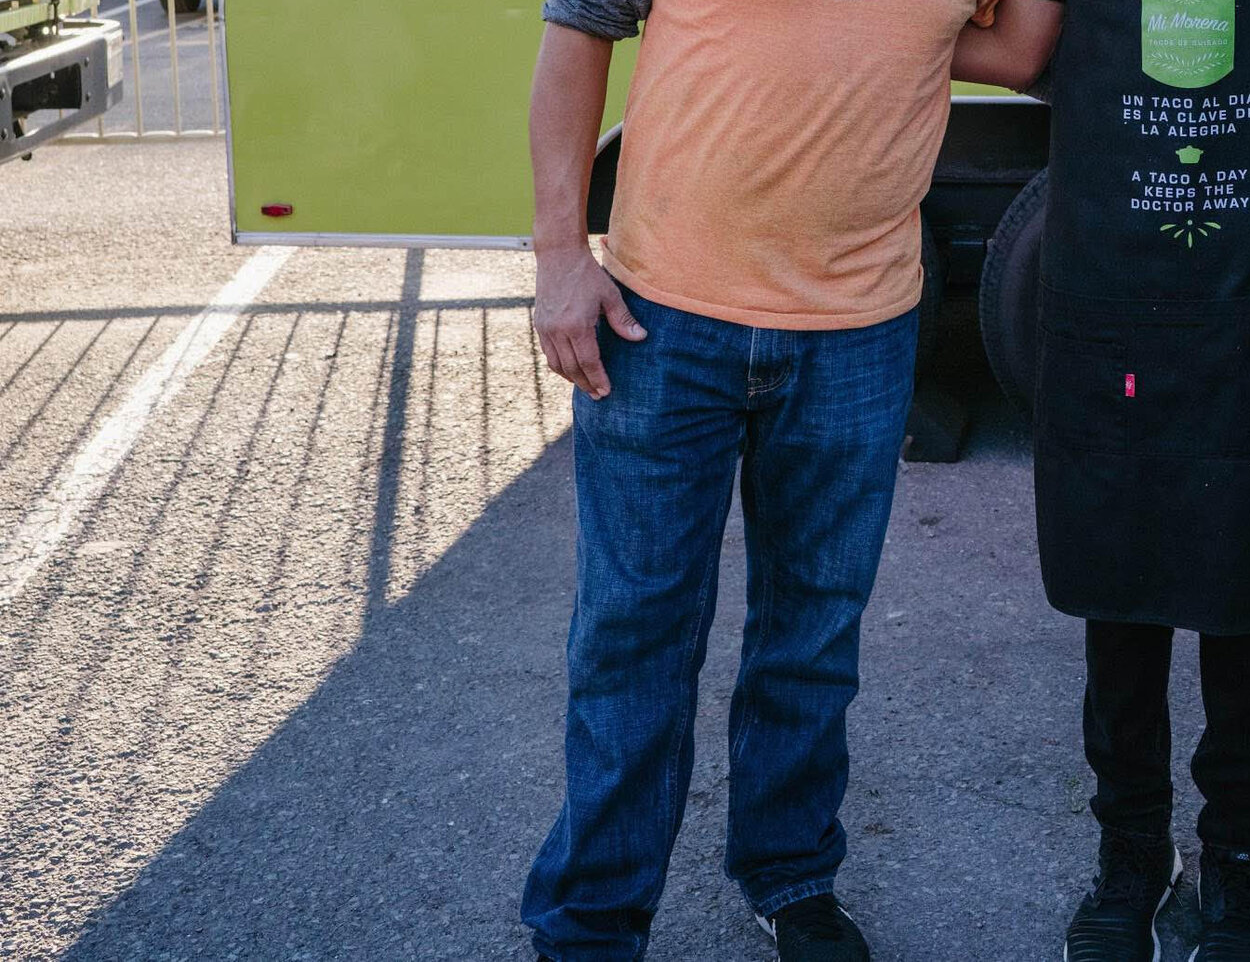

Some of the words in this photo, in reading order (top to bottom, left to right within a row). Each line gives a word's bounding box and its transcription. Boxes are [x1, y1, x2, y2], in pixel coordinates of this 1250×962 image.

[1148, 14, 1167, 33] Mi
[1170, 11, 1229, 32] Morena
[1122, 94, 1144, 107] UN
[1151, 96, 1194, 108] TACO
[1202, 96, 1220, 108] AL
[1123, 108, 1142, 121] ES
[1150, 111, 1169, 123] LA
[1177, 110, 1227, 124] CLAVE
[1141, 124, 1159, 136] LA
[1168, 123, 1236, 137] ALEGRIA
[1131, 170, 1141, 182] A
[1149, 171, 1191, 185] TACO
[1199, 172, 1208, 183] A
[1217, 169, 1249, 182] DAY
[1144, 185, 1196, 198] KEEPS
[1204, 184, 1234, 196] THE
[1131, 198, 1194, 212] DOCTOR
[1203, 197, 1250, 211] AWAY
